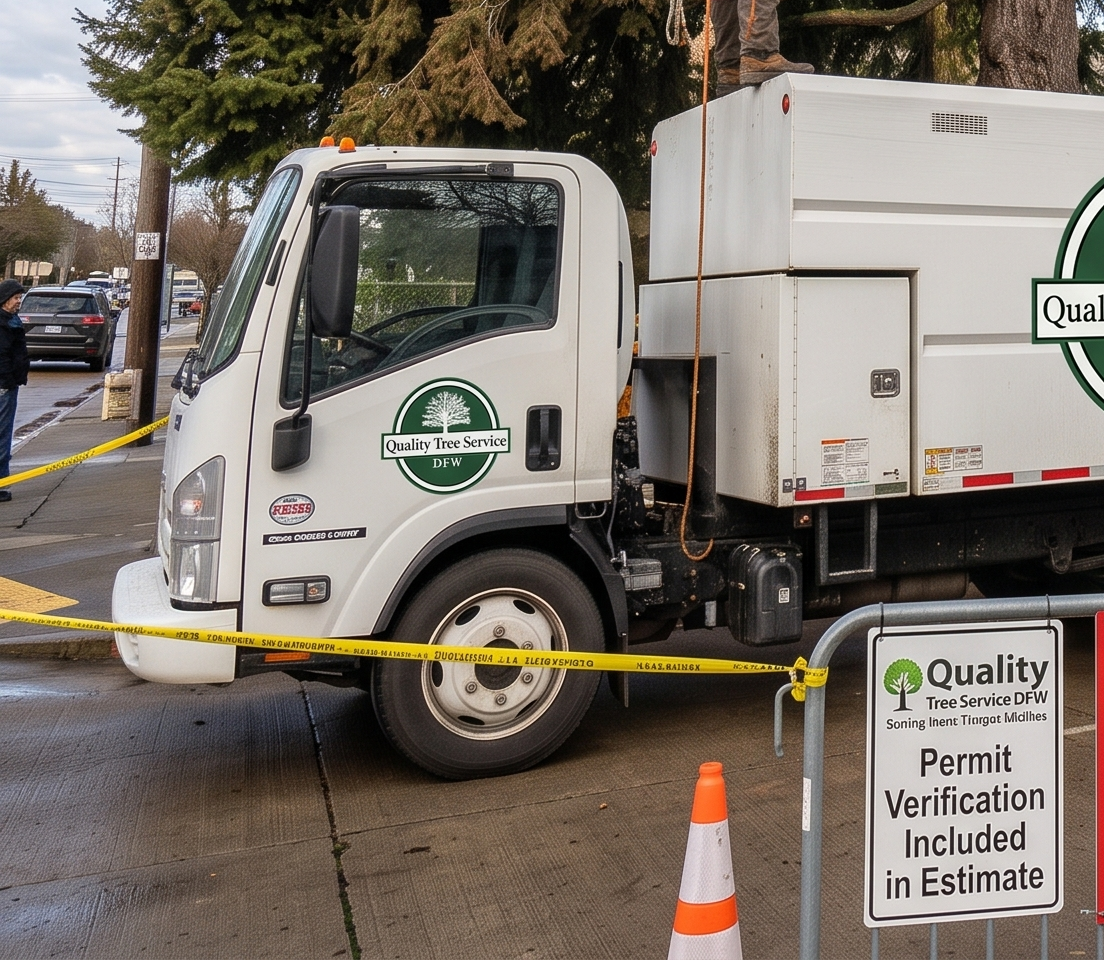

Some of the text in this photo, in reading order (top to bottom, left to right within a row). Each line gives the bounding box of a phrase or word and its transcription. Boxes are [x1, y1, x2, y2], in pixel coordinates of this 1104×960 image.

[386, 435, 507, 454] Quality Tree Service
[432, 457, 462, 468] DFW
[927, 653, 1050, 691] Quality
[926, 690, 1049, 711] Tree Service DFW
[886, 717, 926, 731] Soning
[920, 744, 1012, 778] Permit
[884, 782, 1045, 819] Verification
[905, 821, 1026, 859] Included
[886, 861, 1044, 900] in Estimate
